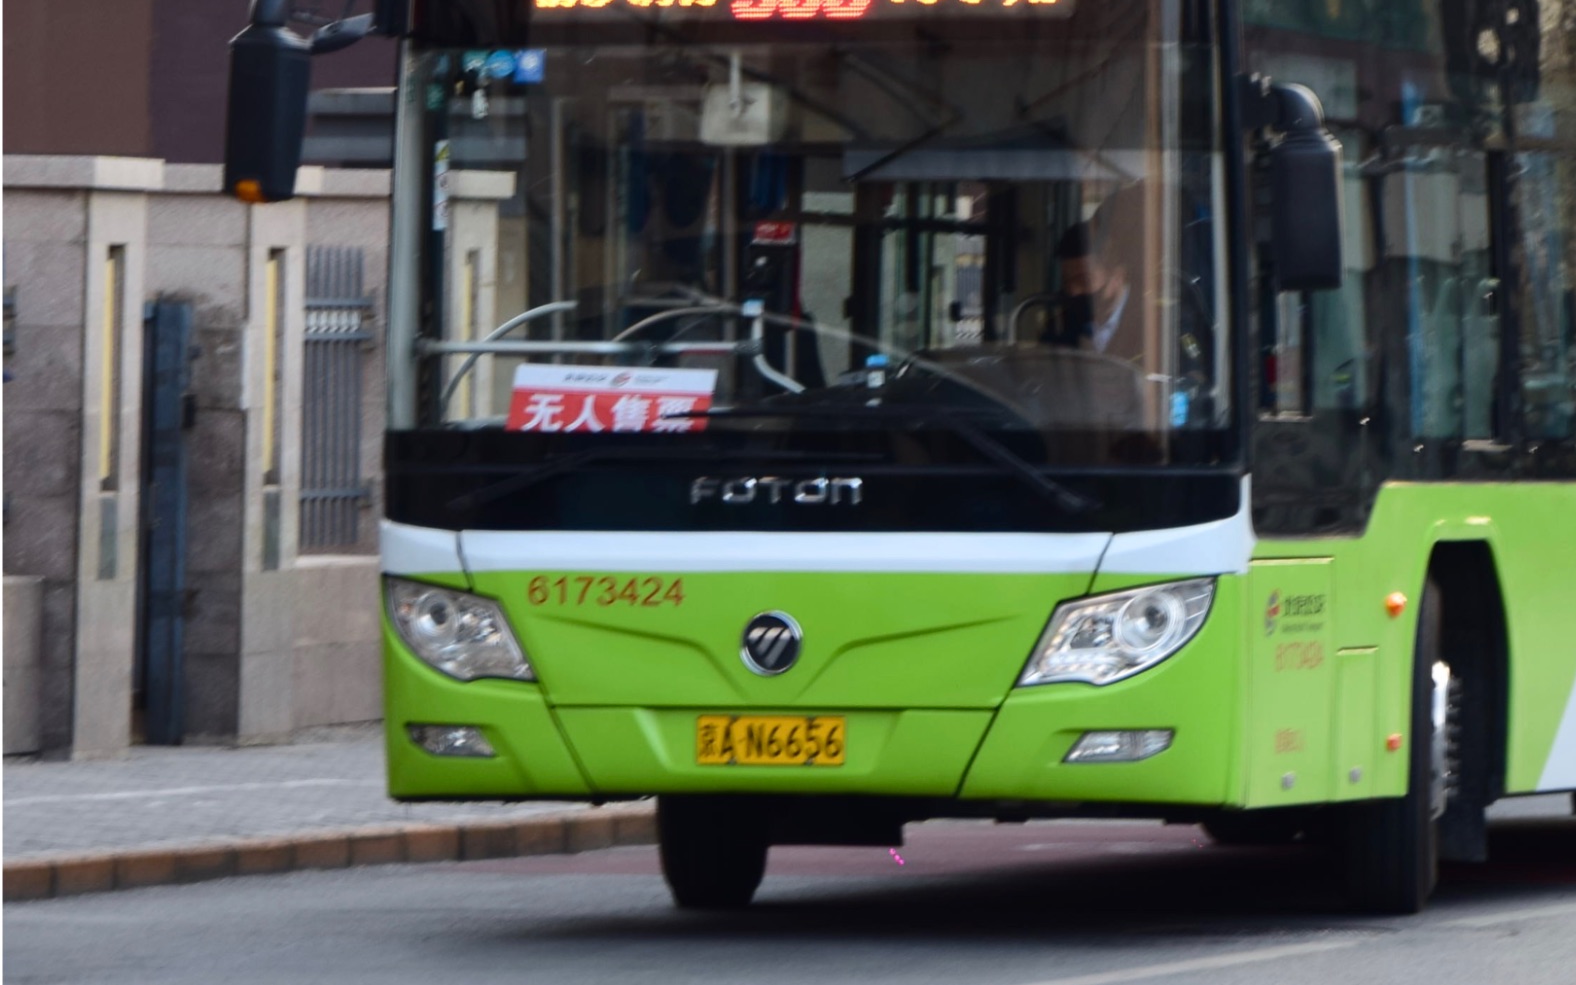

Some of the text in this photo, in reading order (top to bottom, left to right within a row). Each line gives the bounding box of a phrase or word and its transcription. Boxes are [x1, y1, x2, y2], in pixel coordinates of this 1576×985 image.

[519, 392, 699, 432] 无人售票
[690, 475, 863, 505] FOTON
[527, 576, 685, 607] 6173424
